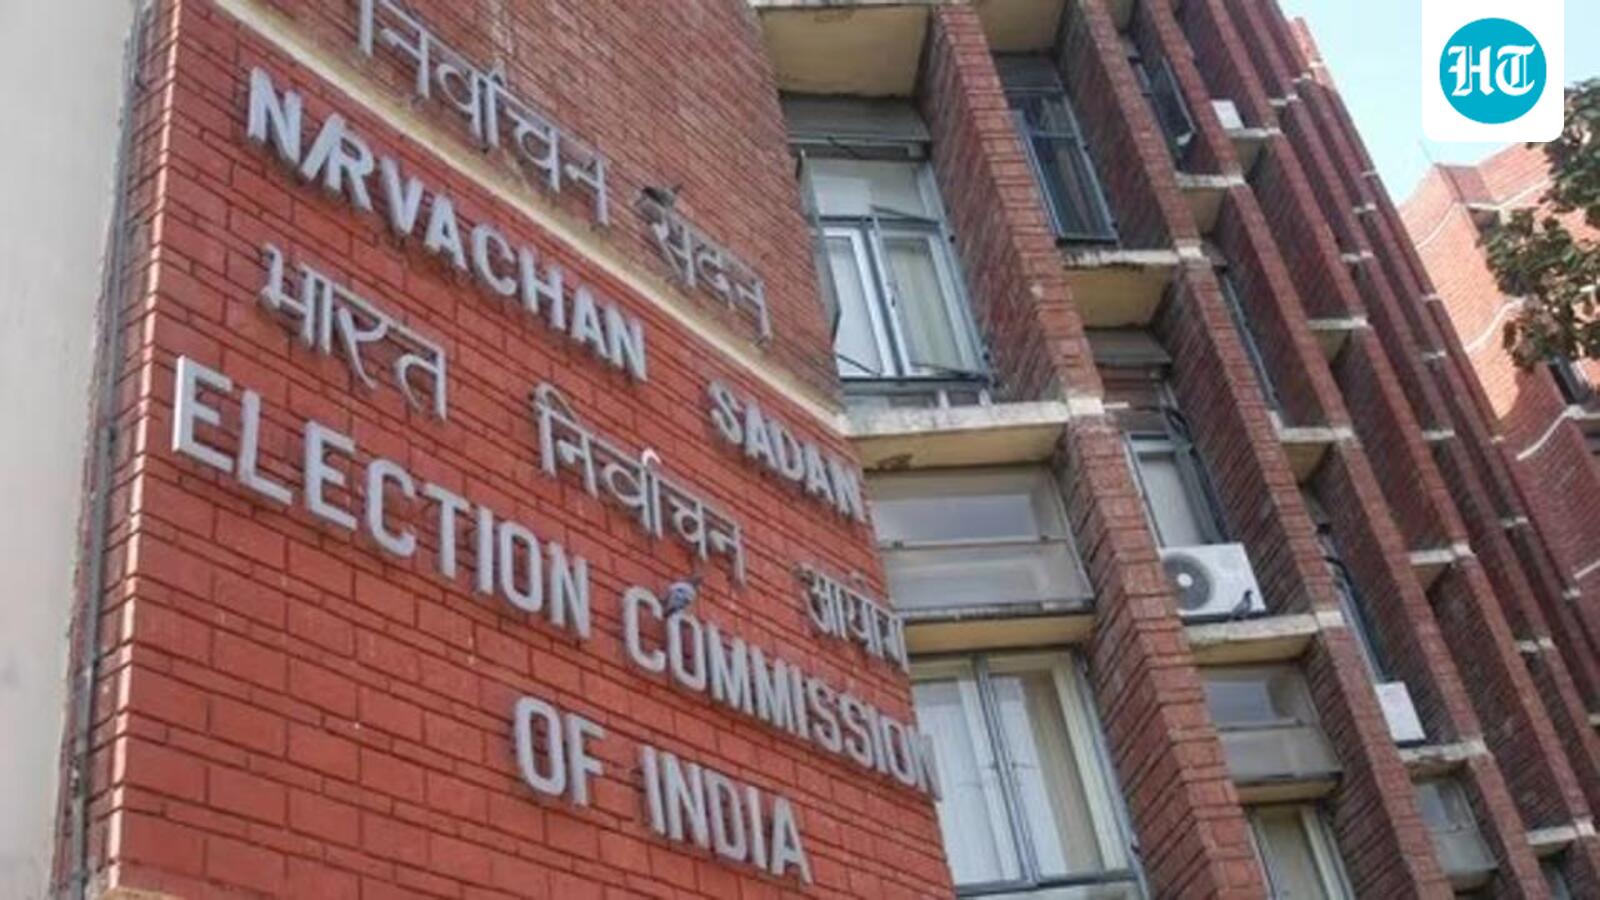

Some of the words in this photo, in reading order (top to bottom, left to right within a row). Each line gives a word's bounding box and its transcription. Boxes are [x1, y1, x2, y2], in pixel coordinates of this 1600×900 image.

[247, 66, 648, 382] NIRVACHAN
[708, 378, 868, 525] SADAN
[358, 0, 610, 226] निर्वाचन
[648, 205, 773, 342] सदन
[171, 354, 591, 640] ELECTION
[623, 585, 943, 801] COMMISSION
[259, 242, 448, 421] भारत
[533, 381, 747, 587] निर्वाचन
[794, 562, 910, 675] आयोग
[513, 695, 606, 808] OF
[640, 744, 814, 887] INDIA
